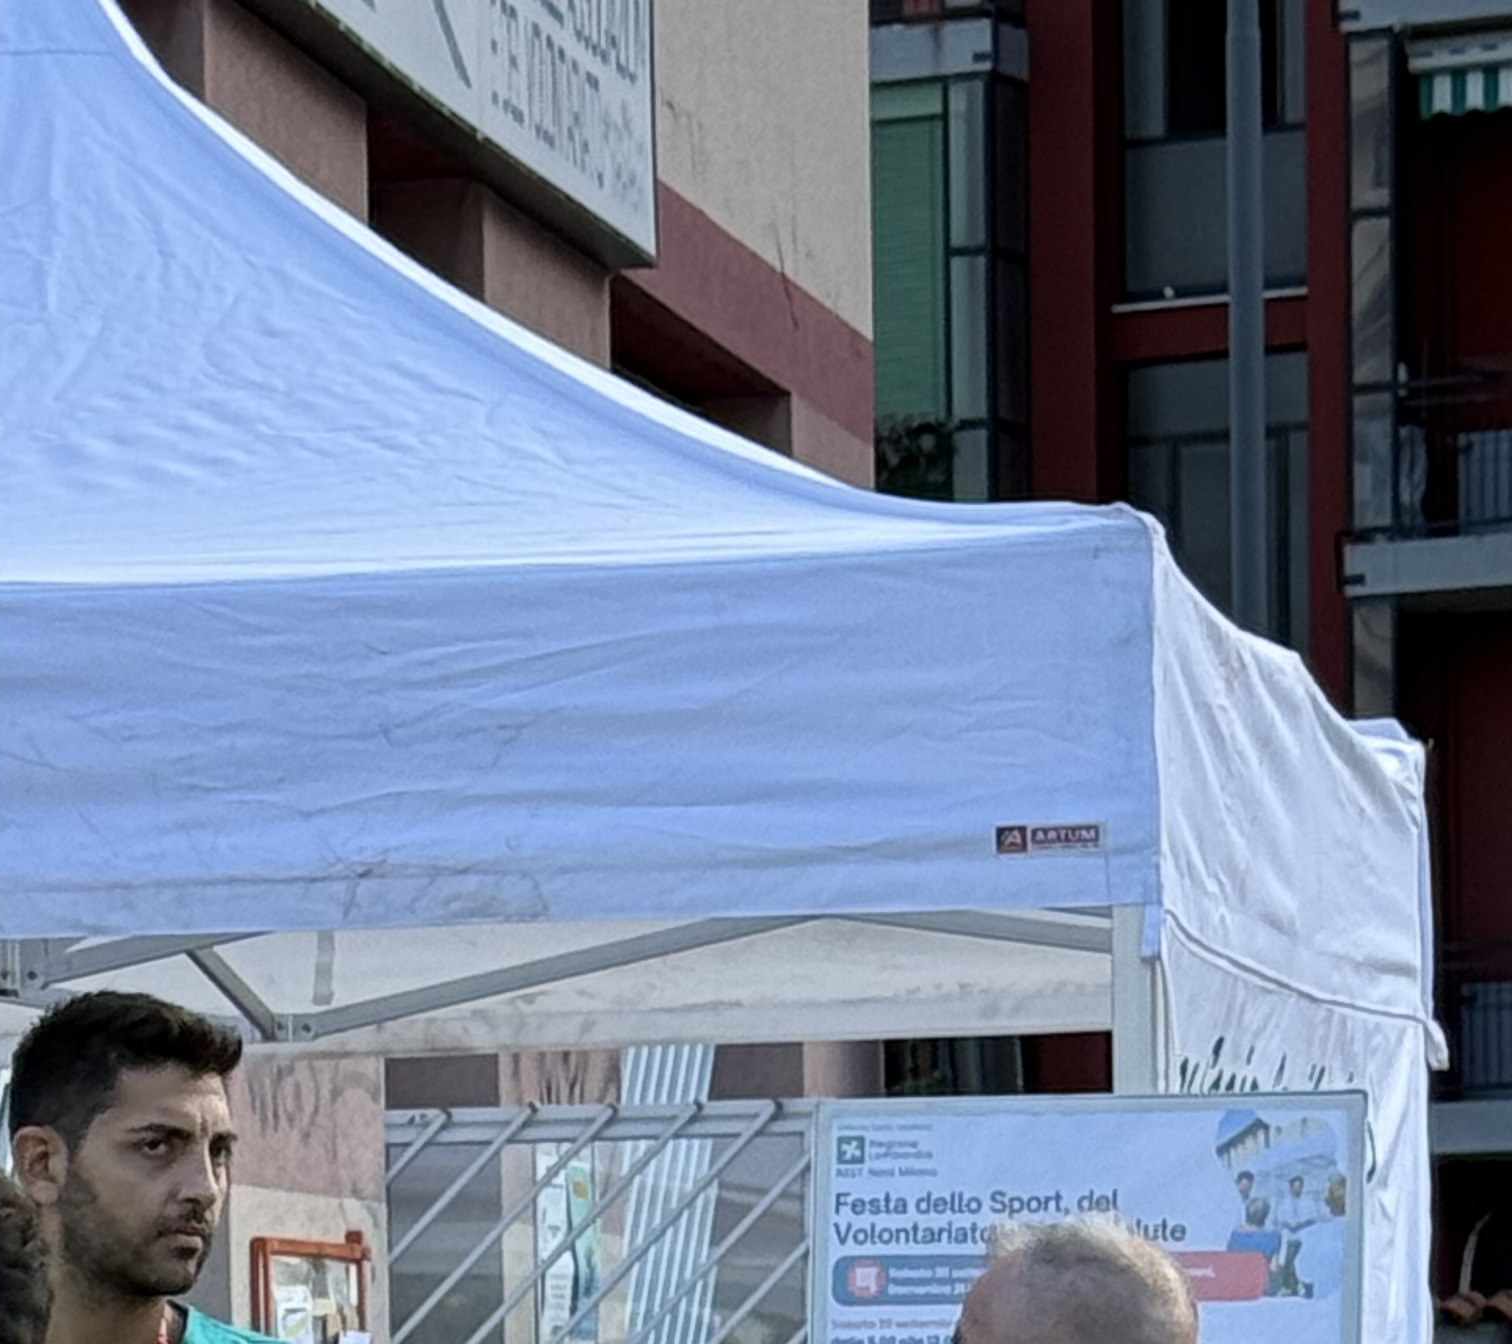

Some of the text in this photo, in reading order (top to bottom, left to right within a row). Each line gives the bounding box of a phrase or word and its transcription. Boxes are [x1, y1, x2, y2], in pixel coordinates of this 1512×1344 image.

[834, 1188, 1118, 1220] Festa dello Sport, del
